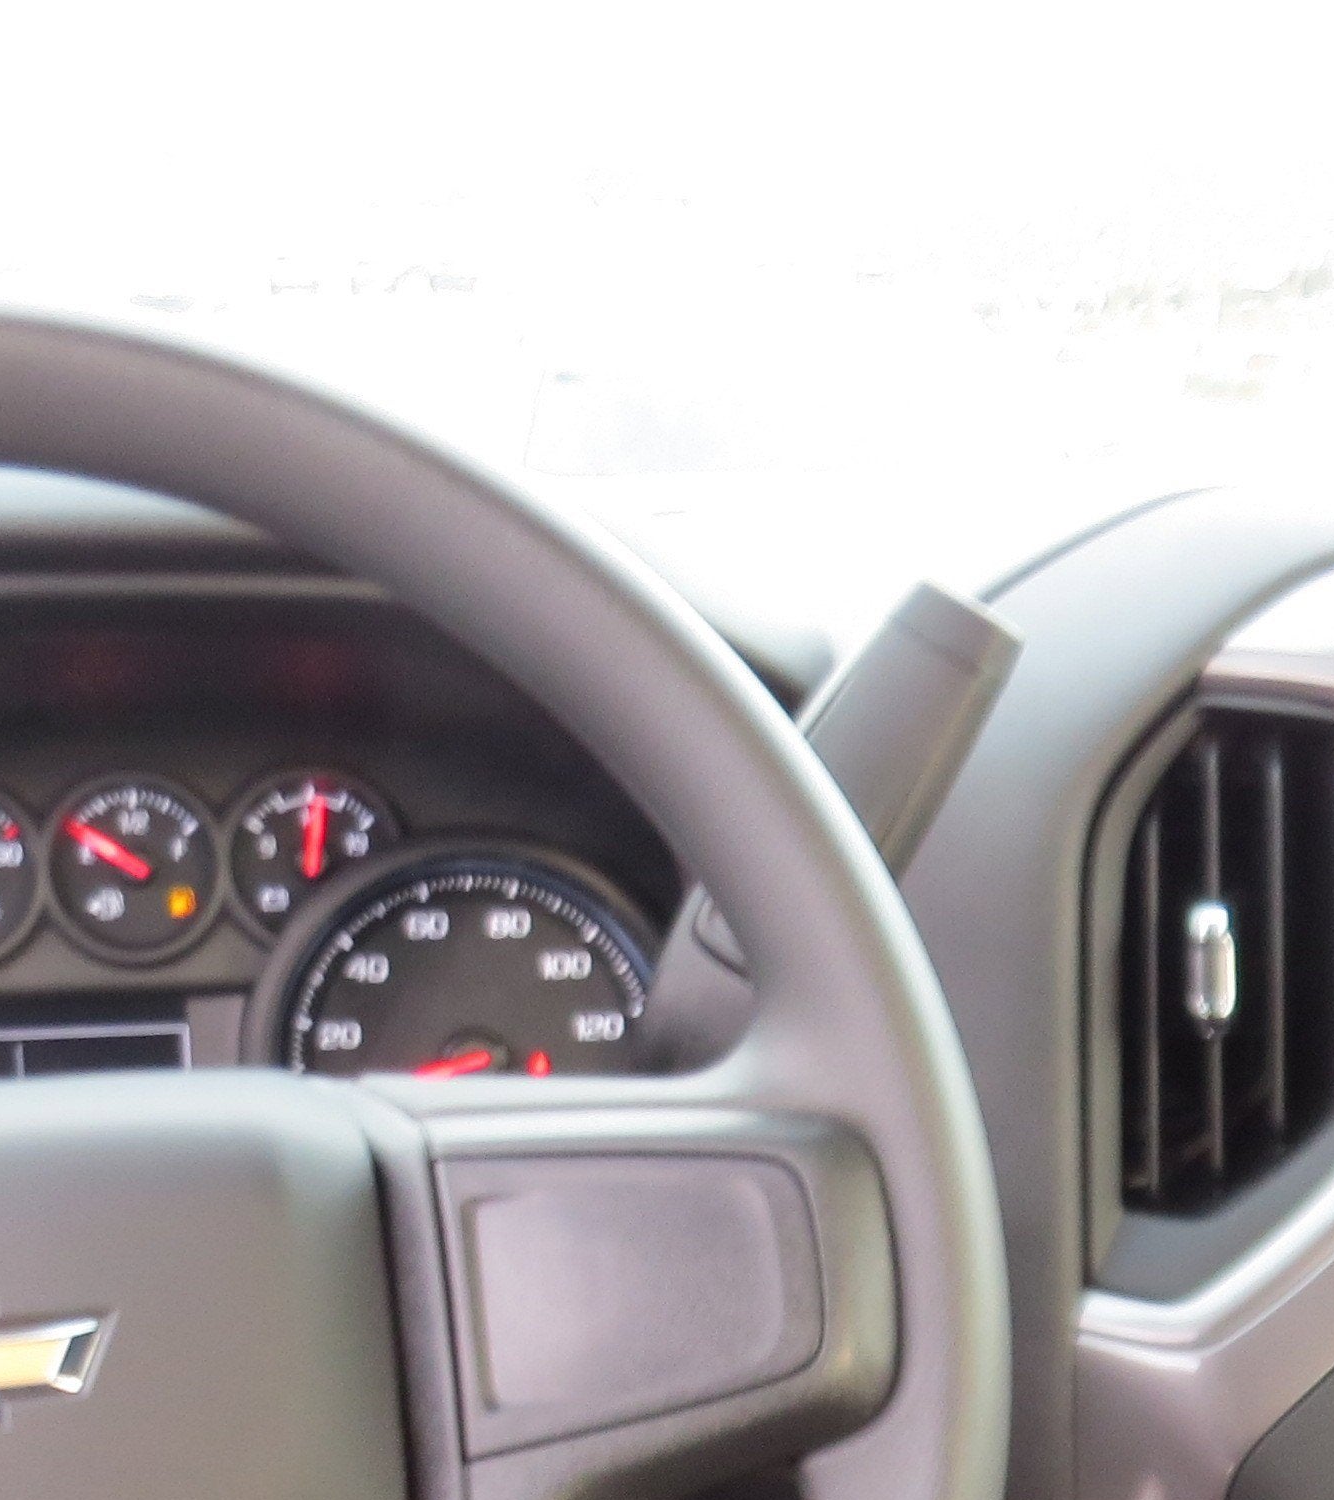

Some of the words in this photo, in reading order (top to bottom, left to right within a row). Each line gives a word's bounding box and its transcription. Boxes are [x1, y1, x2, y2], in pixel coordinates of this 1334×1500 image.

[403, 908, 450, 940] 60
[485, 906, 532, 940] 80
[342, 952, 390, 984] 40
[538, 948, 592, 981] 100
[318, 1018, 362, 1050] 20
[573, 1010, 624, 1043] 120
